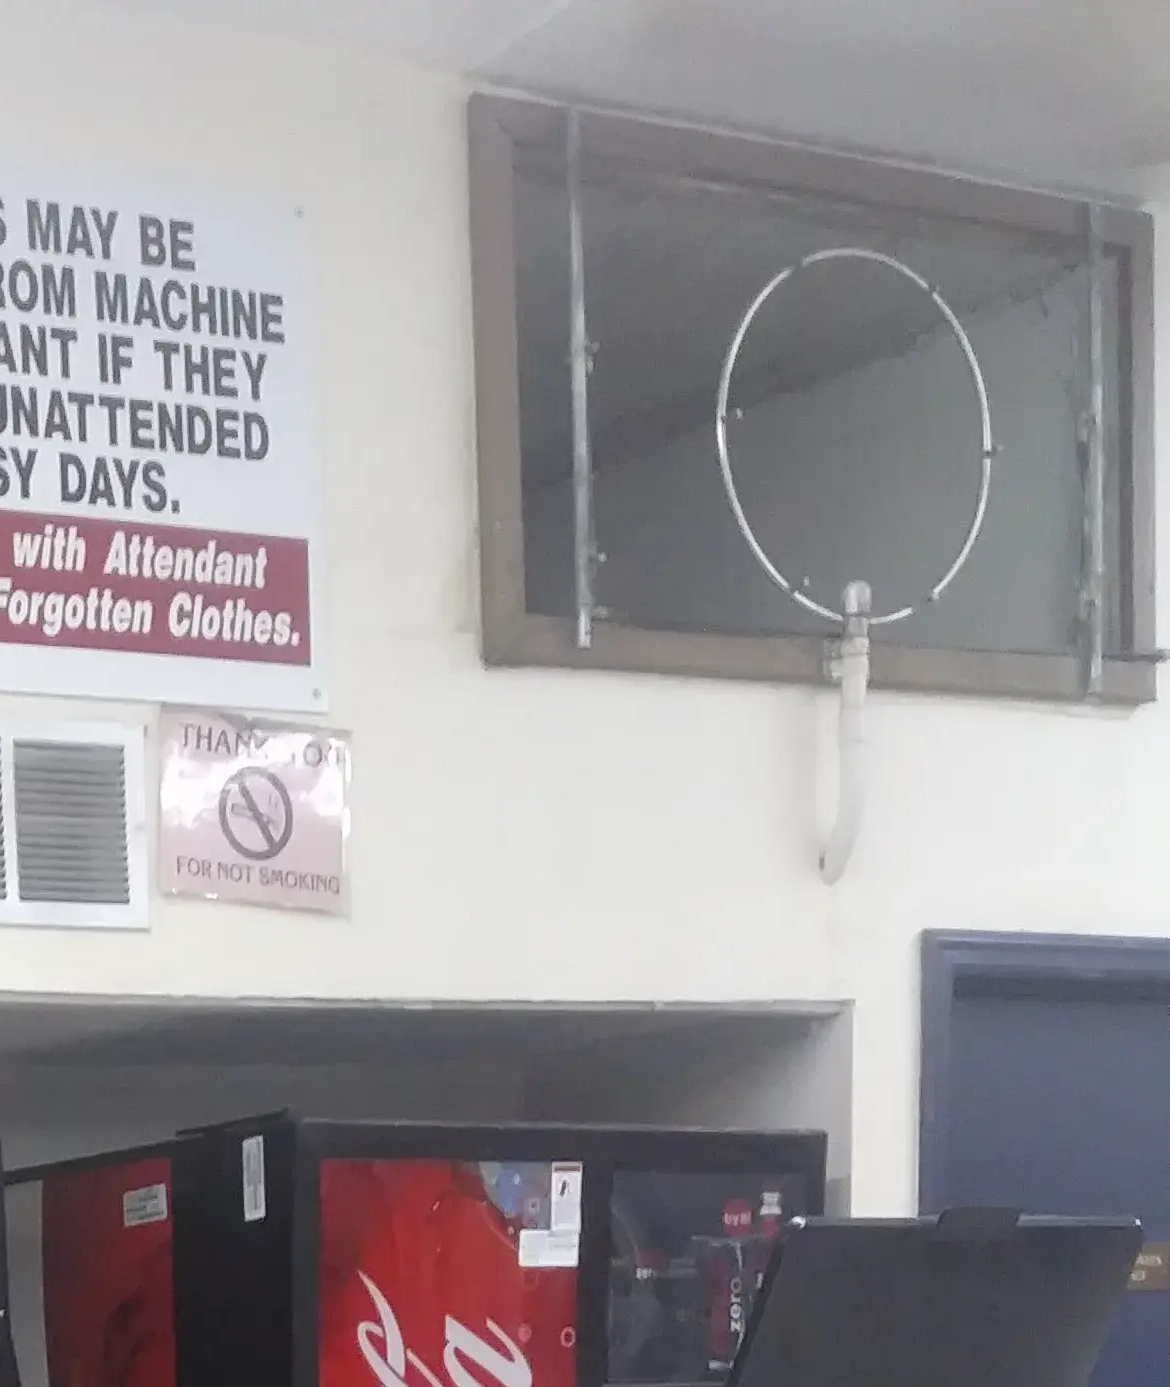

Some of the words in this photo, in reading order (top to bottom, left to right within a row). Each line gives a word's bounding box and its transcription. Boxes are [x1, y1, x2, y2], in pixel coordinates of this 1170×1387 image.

[27, 199, 118, 260] MAY
[139, 215, 196, 271] BE
[94, 271, 285, 344] MACHINE
[98, 333, 133, 385] IF
[153, 340, 266, 401] THEY
[59, 452, 180, 514] DAYS.
[14, 524, 85, 571] with
[104, 531, 267, 588] Attendant
[169, 592, 300, 646] Clothes.
[182, 723, 269, 757] THAN
[176, 855, 211, 881] FOR
[217, 861, 255, 885] NOT
[259, 866, 341, 895] SMOKING
